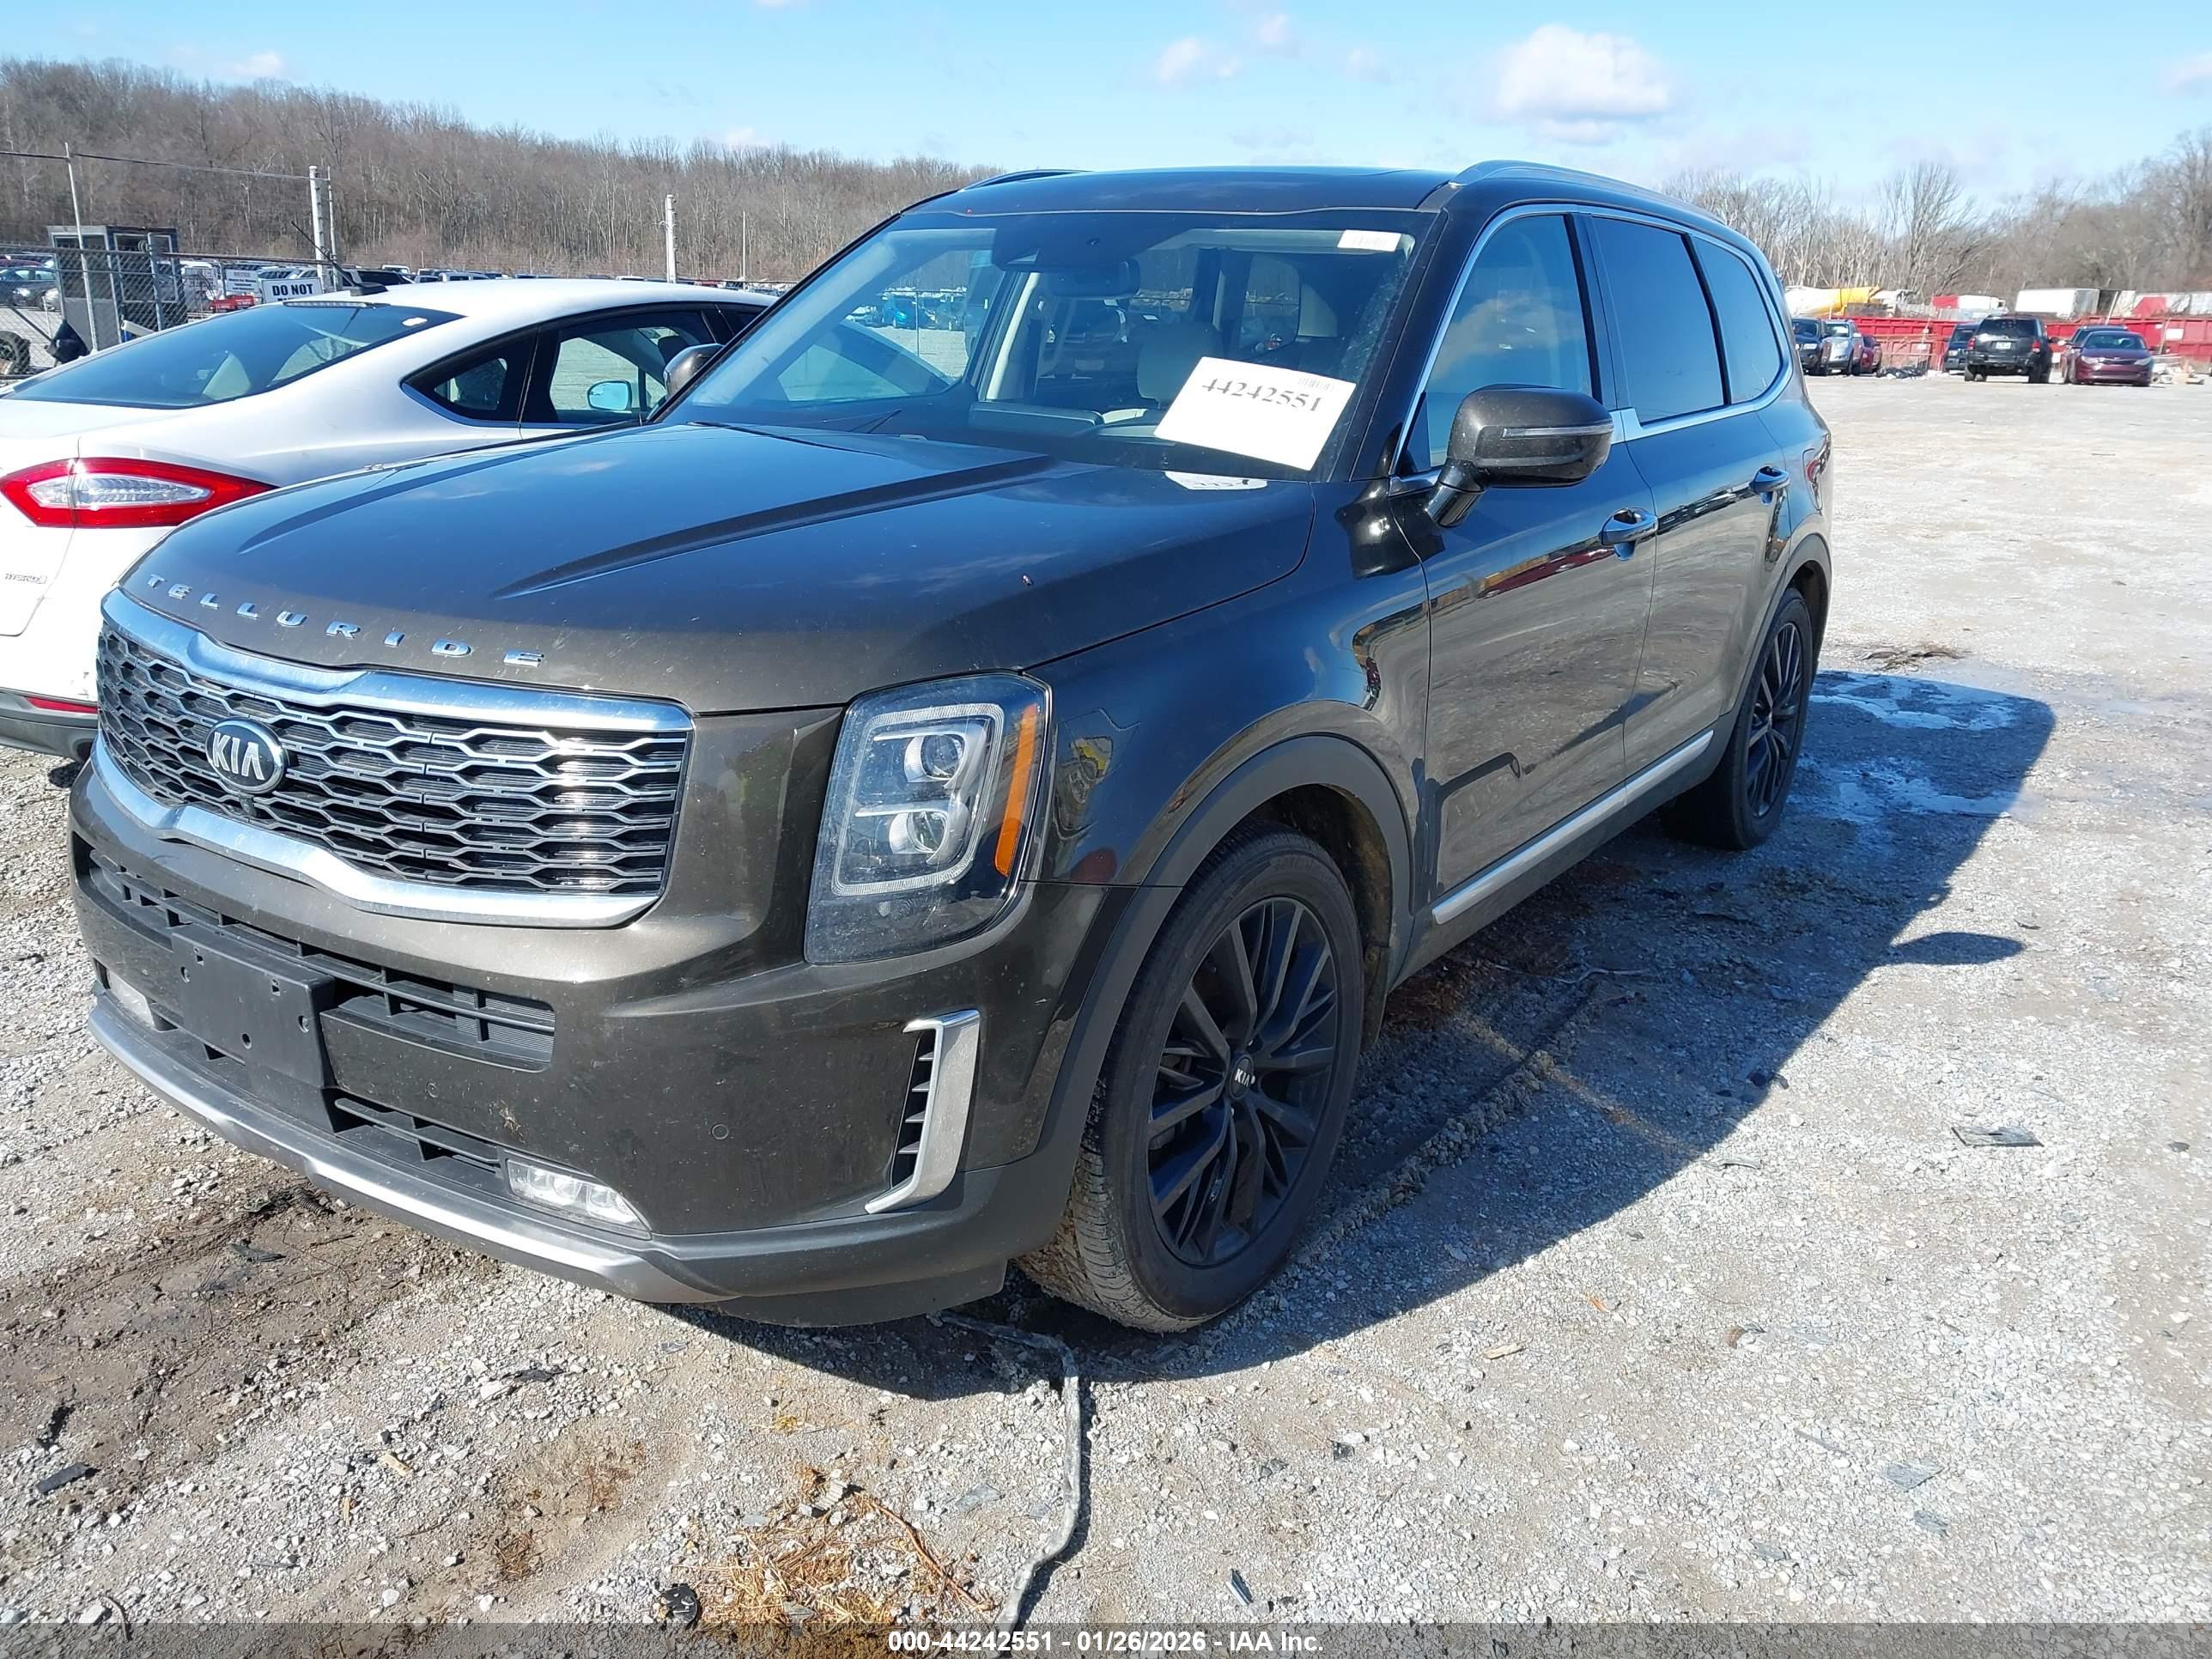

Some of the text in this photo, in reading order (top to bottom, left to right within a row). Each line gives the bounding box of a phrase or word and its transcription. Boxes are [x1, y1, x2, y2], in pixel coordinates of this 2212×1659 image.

[271, 283, 313, 296] DO NOT
[1202, 378, 1322, 412] 44242551
[146, 573, 545, 667] TELLURIDE
[212, 731, 265, 781] KIA
[1235, 1068, 1250, 1087] KIA
